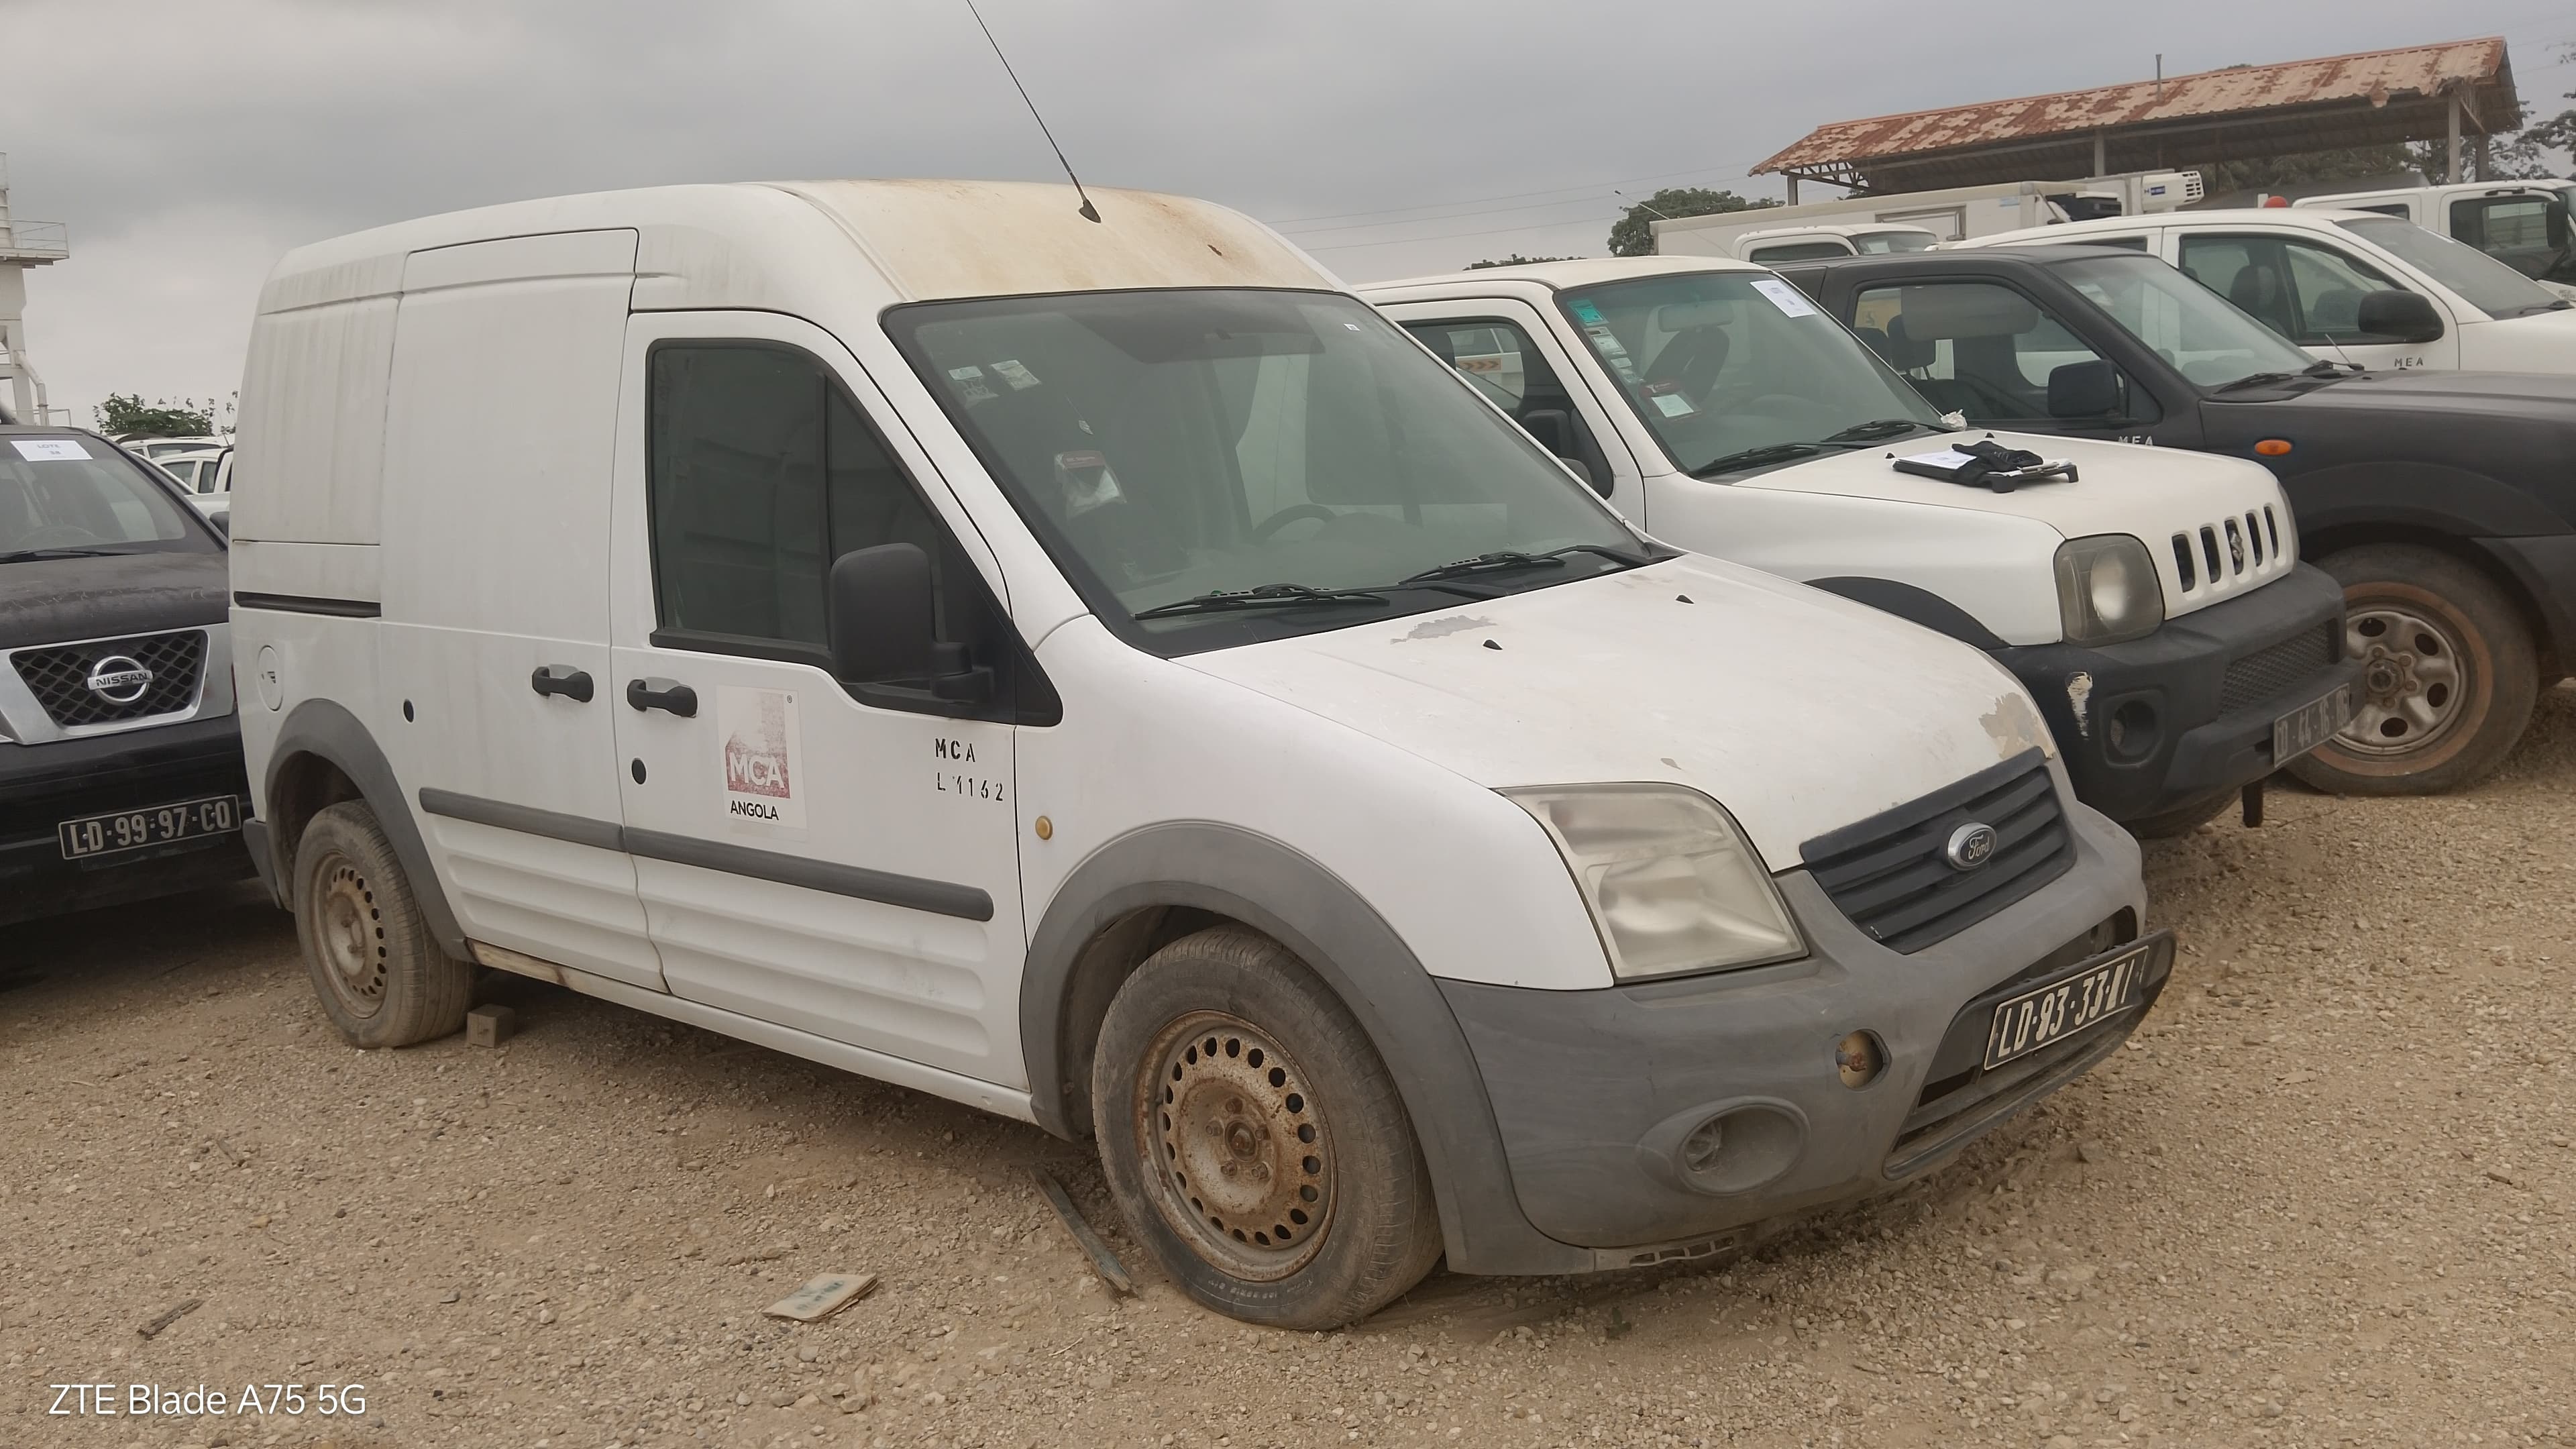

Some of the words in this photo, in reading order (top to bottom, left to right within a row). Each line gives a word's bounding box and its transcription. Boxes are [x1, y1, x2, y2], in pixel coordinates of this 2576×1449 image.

[2394, 357, 2424, 367] MEA
[96, 673, 148, 686] NISSAN
[935, 738, 975, 763] MCA
[729, 751, 785, 789] MCA
[731, 800, 780, 820] ANGOLA
[1968, 835, 1990, 860] Ford
